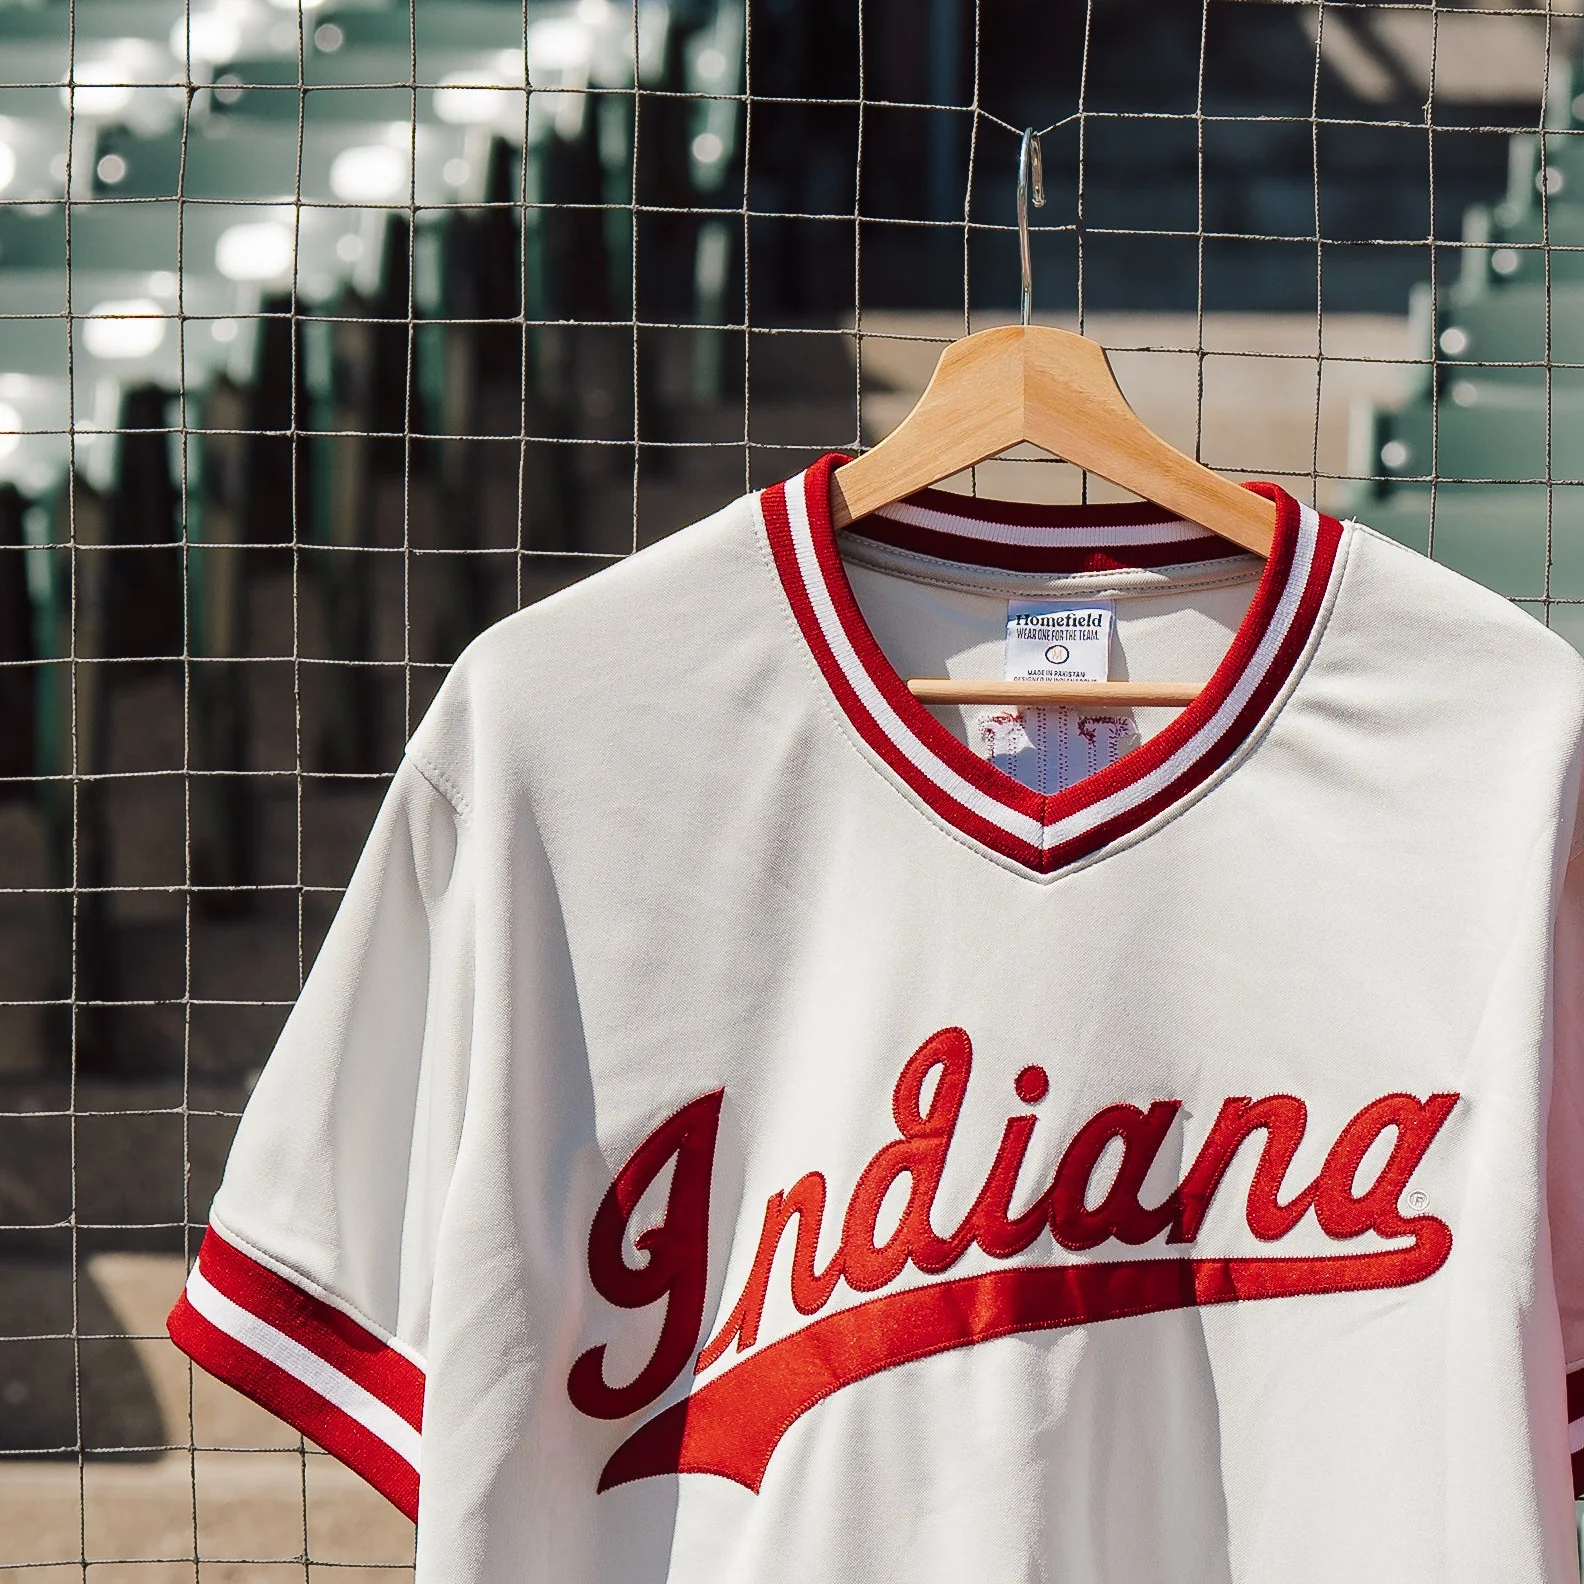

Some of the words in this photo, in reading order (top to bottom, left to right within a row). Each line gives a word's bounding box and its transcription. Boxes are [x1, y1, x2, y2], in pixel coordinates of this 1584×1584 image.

[1016, 613, 1102, 628] Homefield
[1016, 628, 1036, 640] WEAR
[1037, 628, 1050, 641] ONE
[1051, 629, 1064, 642] FOR
[1065, 629, 1077, 641] THE
[1054, 670, 1086, 678] PAKISTAN
[567, 1026, 1461, 1421] Indiana
